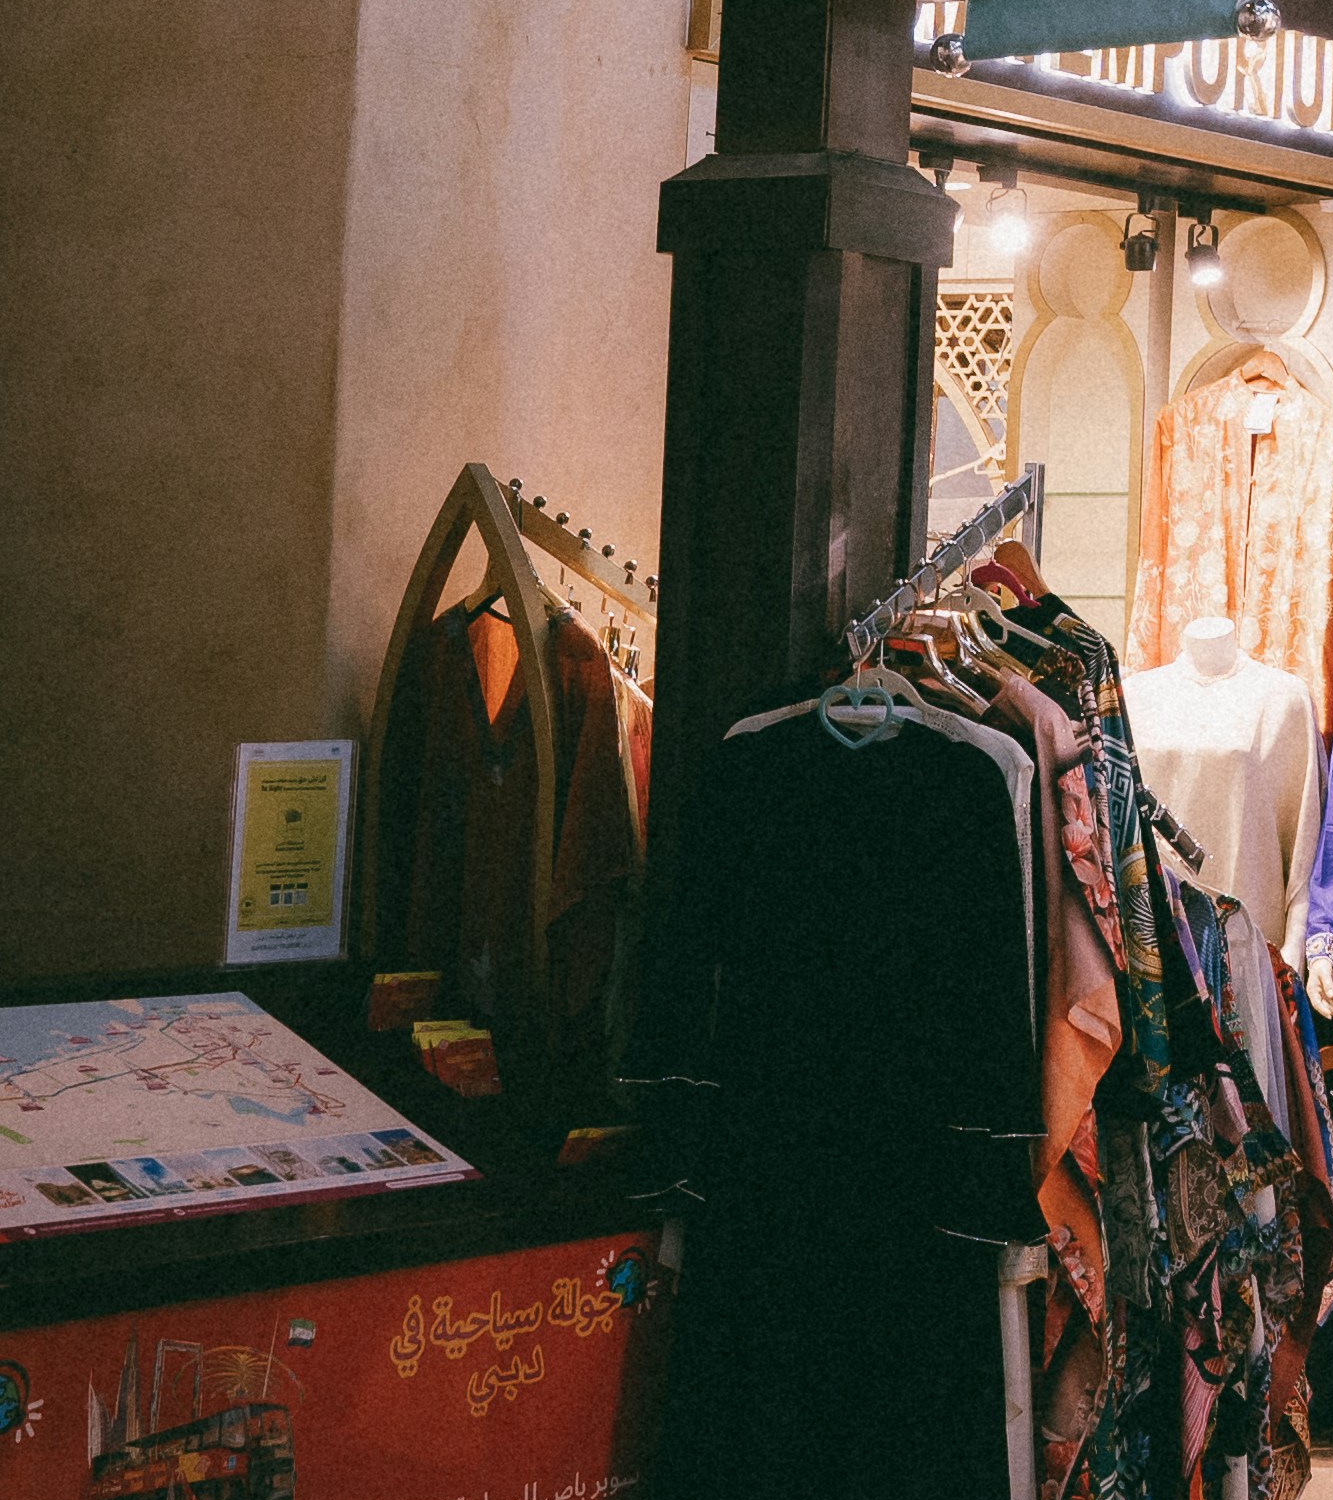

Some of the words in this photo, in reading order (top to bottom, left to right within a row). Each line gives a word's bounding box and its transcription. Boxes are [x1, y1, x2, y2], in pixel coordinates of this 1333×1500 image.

[389, 1294, 425, 1378] في
[430, 1290, 543, 1359] سياحية
[547, 1277, 623, 1337] جولة
[467, 1343, 545, 1417] دبي
